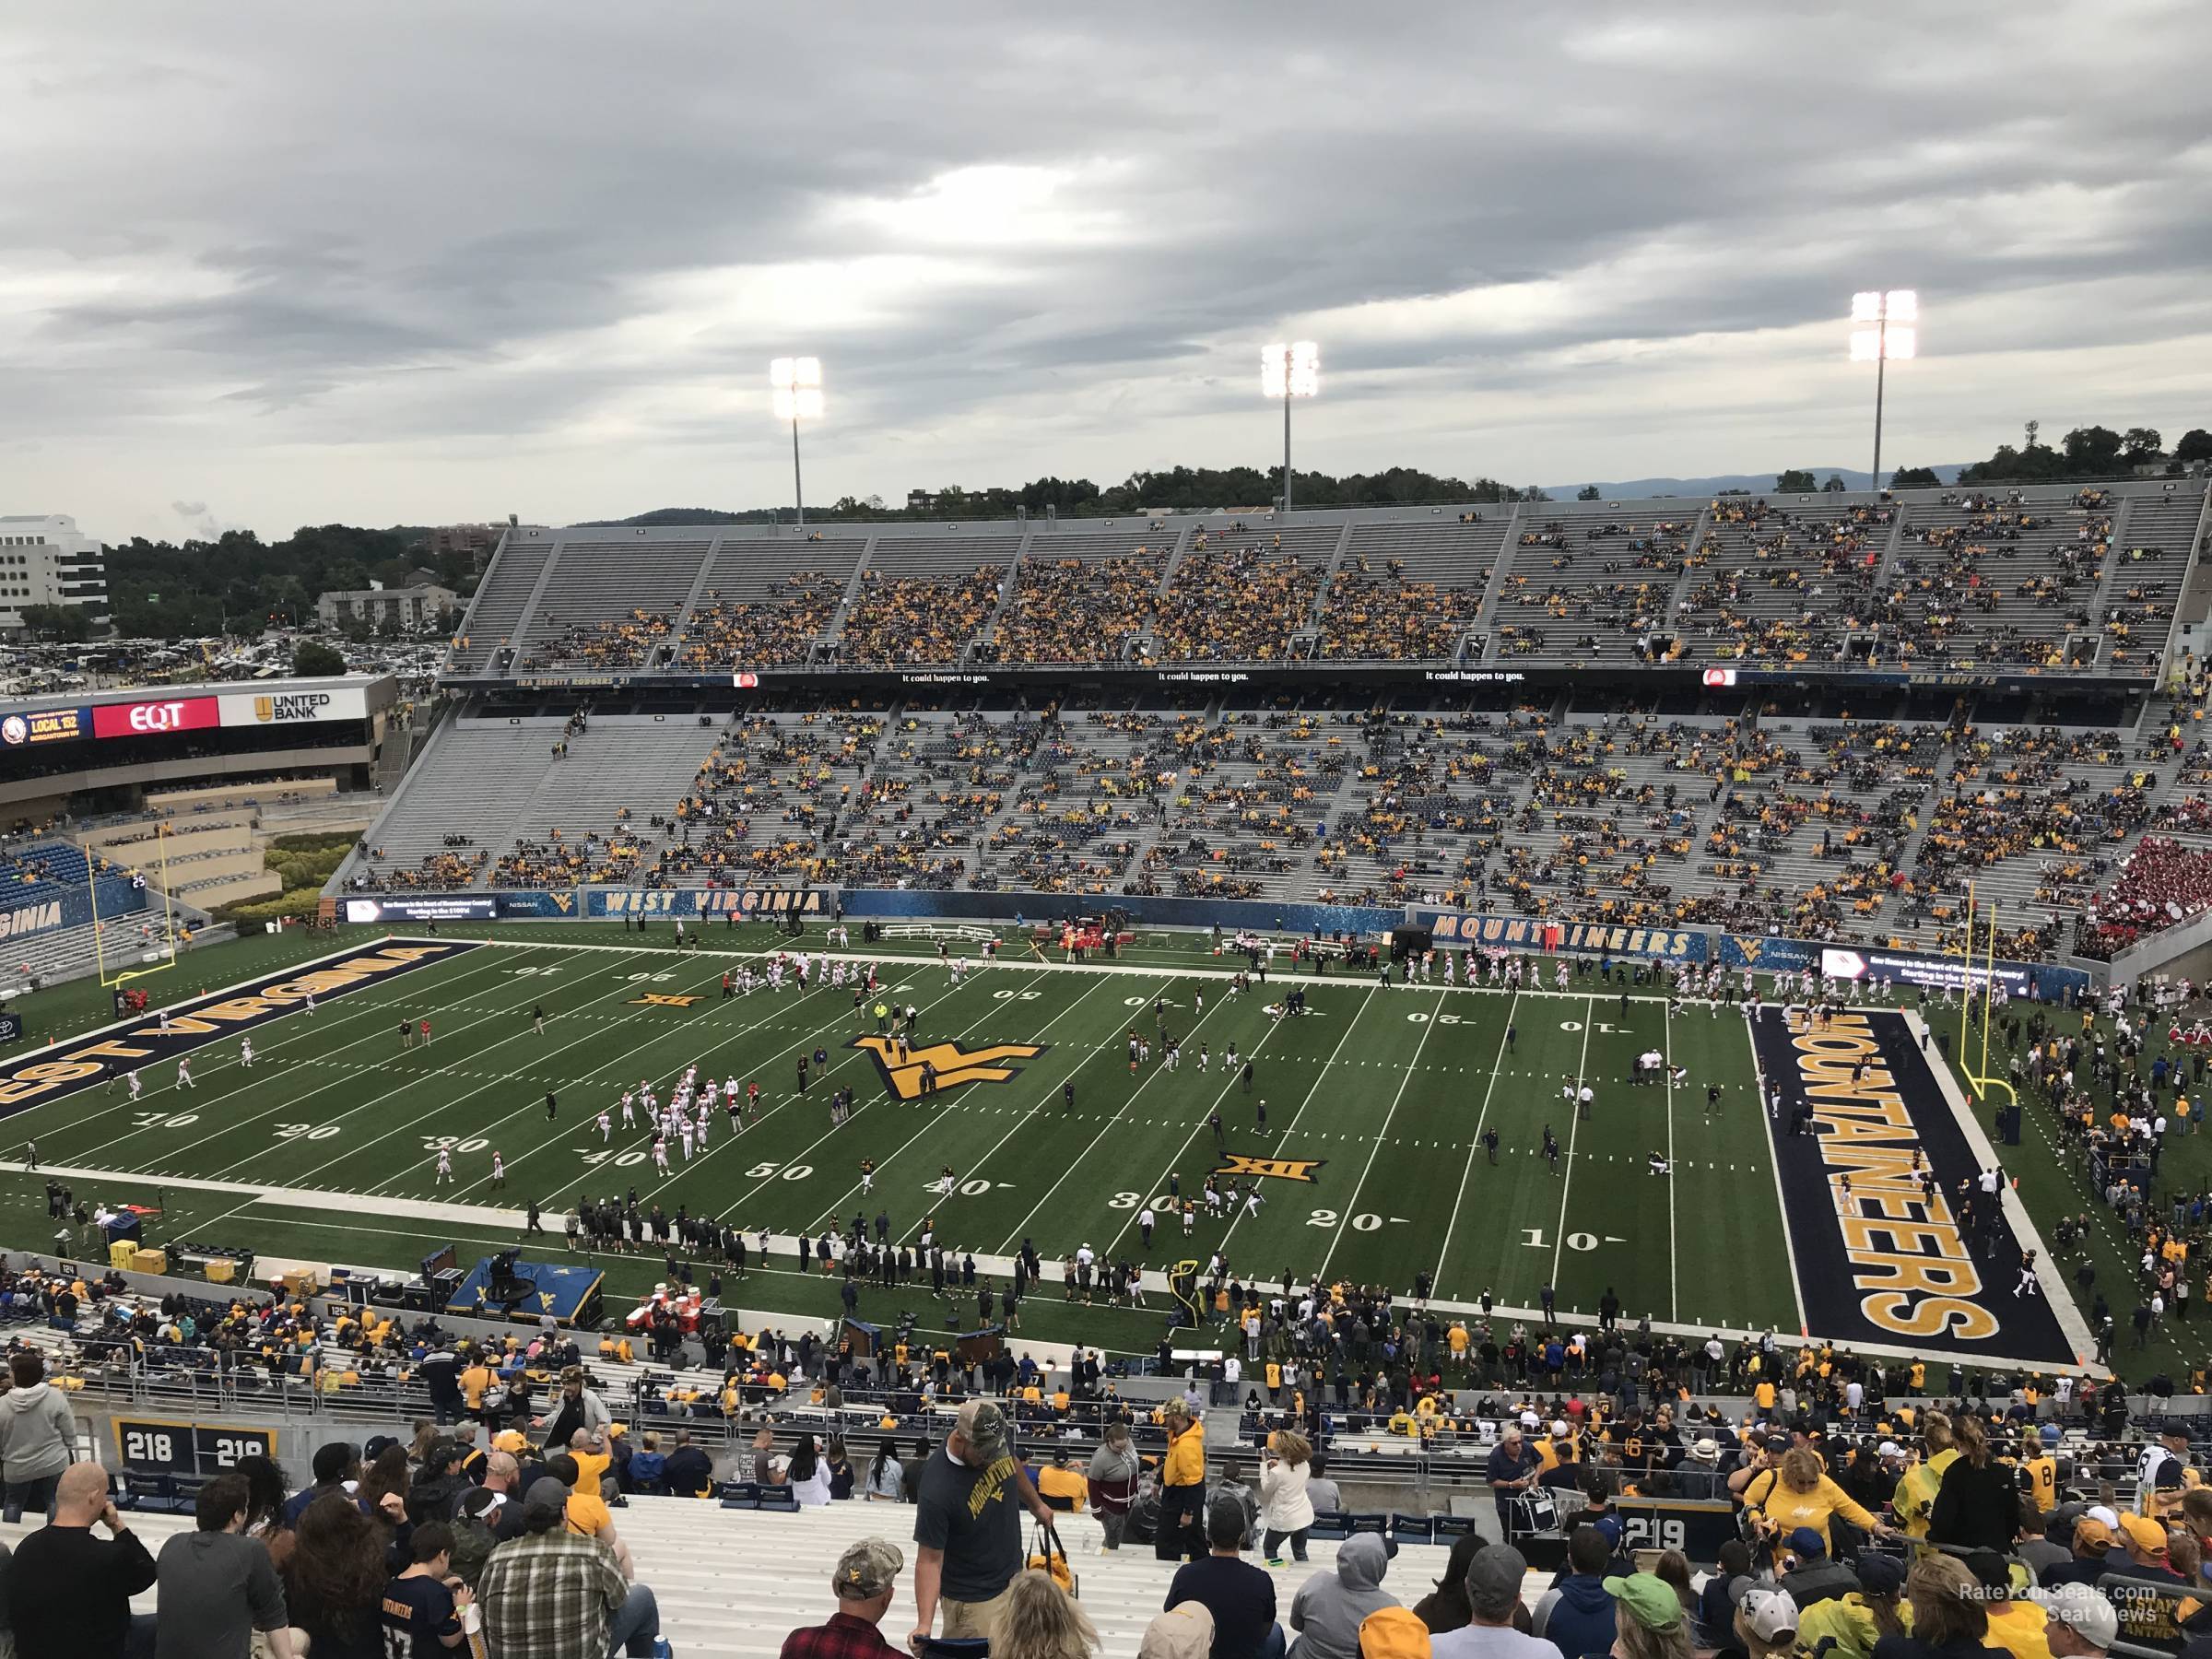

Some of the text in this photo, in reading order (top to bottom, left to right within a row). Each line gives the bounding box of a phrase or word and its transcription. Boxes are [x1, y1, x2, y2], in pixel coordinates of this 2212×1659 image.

[911, 674, 931, 682] could
[934, 674, 960, 683] happen
[973, 675, 990, 684] you.
[1159, 672, 1165, 680] It
[1167, 672, 1188, 680] could
[1191, 672, 1218, 682] happen
[1231, 674, 1248, 682] you.
[1426, 671, 1433, 680] It
[1434, 671, 1458, 680] could
[1460, 671, 1492, 682] happen
[1506, 673, 1524, 682] you.
[1909, 675, 1998, 686] SAM HUFF 75
[273, 693, 330, 708] UNITED
[129, 702, 184, 731] EQT
[275, 706, 317, 720] BANK
[31, 715, 77, 734] LOCAL 152
[29, 731, 70, 742] MORGANTOWN
[133, 876, 146, 888] 25
[606, 891, 820, 911] WEST VIRGINIA
[1770, 951, 1808, 960] NISSAN
[1870, 957, 1884, 965] New
[1885, 959, 1906, 968] Homes
[1913, 960, 1924, 970] the
[1926, 962, 1943, 971] Heart
[1953, 964, 1994, 975] Moutainer
[1994, 970, 2024, 981] Country!
[1900, 970, 1934, 981] Starting
[1936, 971, 1945, 981] in
[1945, 972, 1959, 982] the
[129, 946, 452, 1036] VIRGINIA
[131, 1113, 199, 1128] 10
[272, 1124, 341, 1140] 20
[422, 1135, 490, 1153] 30
[581, 1149, 647, 1167] 40
[744, 1161, 814, 1181] 50
[1215, 1154, 1320, 1182] XII
[1787, 1012, 2000, 1338] MOUNTAINEERS
[1108, 1192, 1178, 1212] 30
[1305, 1209, 1382, 1231] 20
[1521, 1229, 1599, 1252] 10
[63, 1264, 74, 1275] 124
[332, 1306, 347, 1316] 125
[1230, 1360, 1235, 1369] 5
[1268, 1370, 1276, 1378] 7
[1315, 1371, 1323, 1379] 18
[2063, 1384, 2070, 1394] 7
[1484, 1429, 1491, 1438] 7
[126, 1431, 172, 1462] 218
[1624, 1438, 1642, 1458] 18
[2138, 1453, 2151, 1482] 8
[2041, 1465, 2052, 1488] 8
[967, 1456, 1017, 1521] MORGANTOWN
[1624, 1517, 1685, 1550] 219
